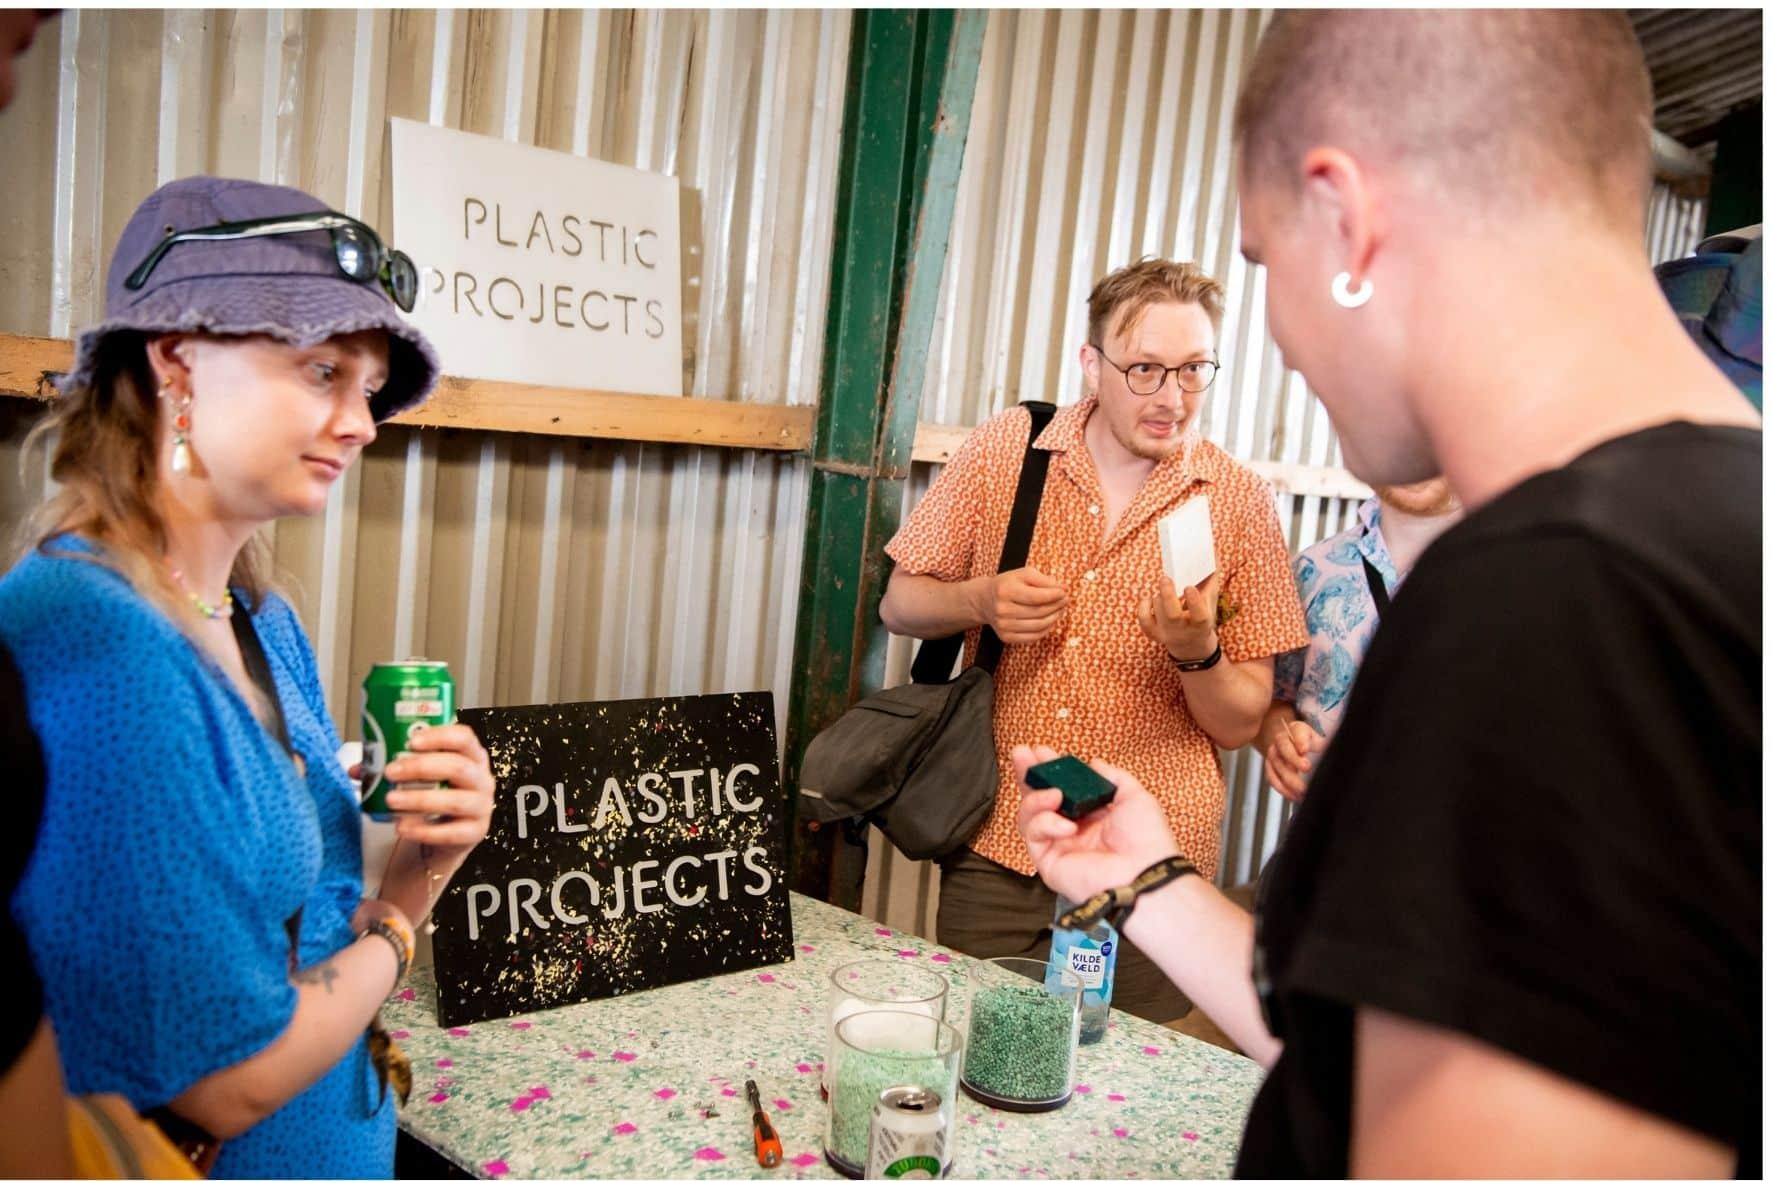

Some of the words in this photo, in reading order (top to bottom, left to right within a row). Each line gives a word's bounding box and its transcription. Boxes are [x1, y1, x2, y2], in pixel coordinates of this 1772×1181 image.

[464, 197, 659, 270] PLASTIC
[422, 267, 664, 339] PROJECTS
[515, 763, 764, 839] PLASTIC
[466, 846, 773, 940] PROJECTS
[1072, 952, 1102, 963] KILDE
[1072, 962, 1101, 973] VÆLD
